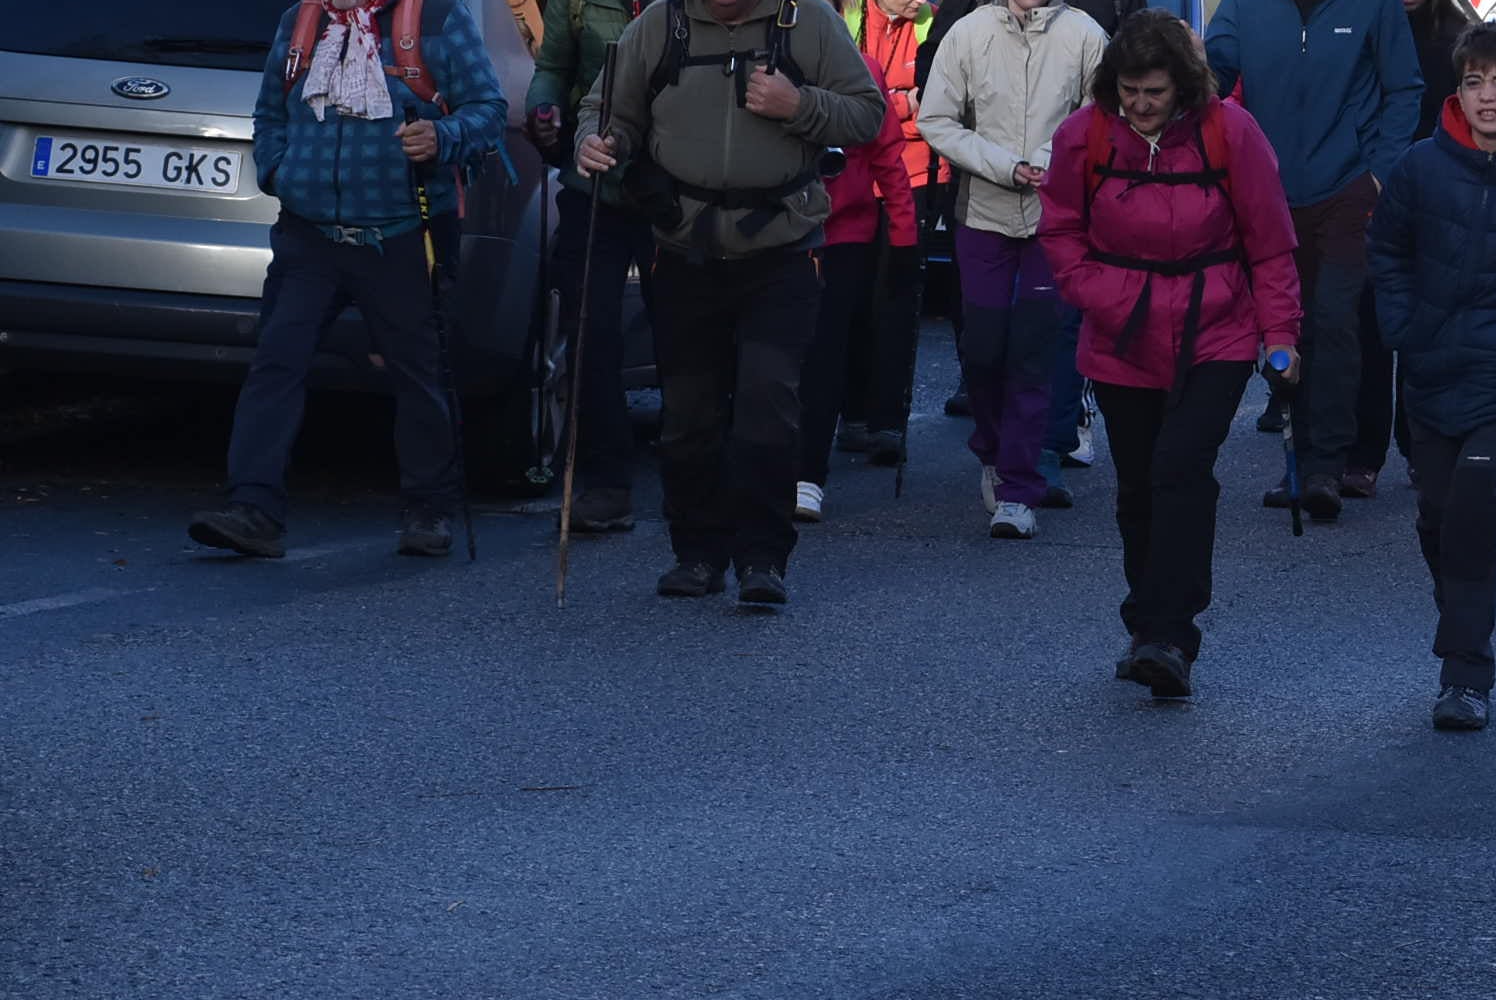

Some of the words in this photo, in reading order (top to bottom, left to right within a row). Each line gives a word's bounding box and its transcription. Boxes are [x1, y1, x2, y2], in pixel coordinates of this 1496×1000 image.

[122, 80, 157, 94] Ford
[36, 160, 46, 170] E
[55, 142, 142, 179] 2955
[161, 151, 232, 187] GKS
